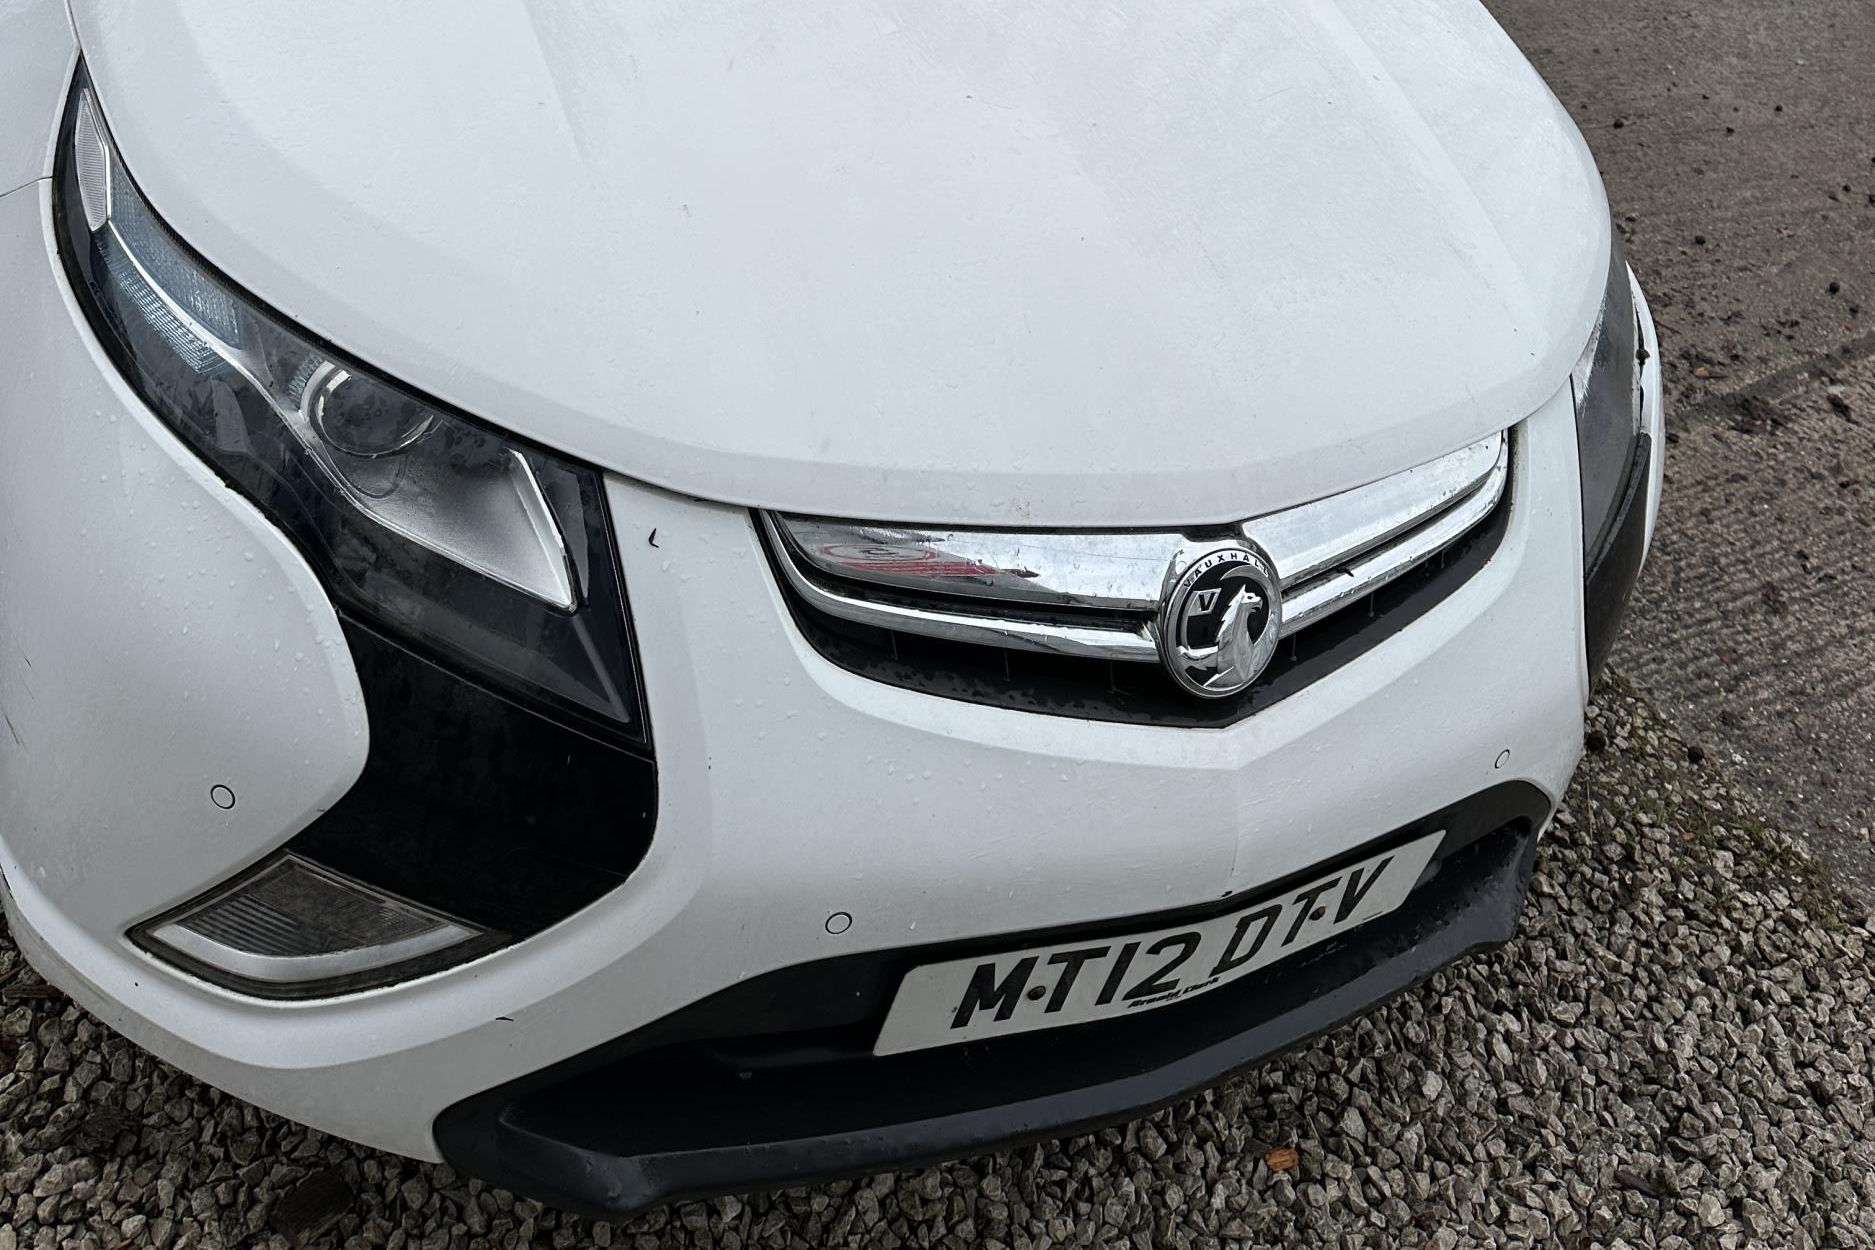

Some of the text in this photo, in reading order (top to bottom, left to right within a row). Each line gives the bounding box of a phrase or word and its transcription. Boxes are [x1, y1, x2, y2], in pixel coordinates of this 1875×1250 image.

[1184, 552, 1269, 588] VAUXHALL
[950, 855, 1395, 1029] MT12 DTV
